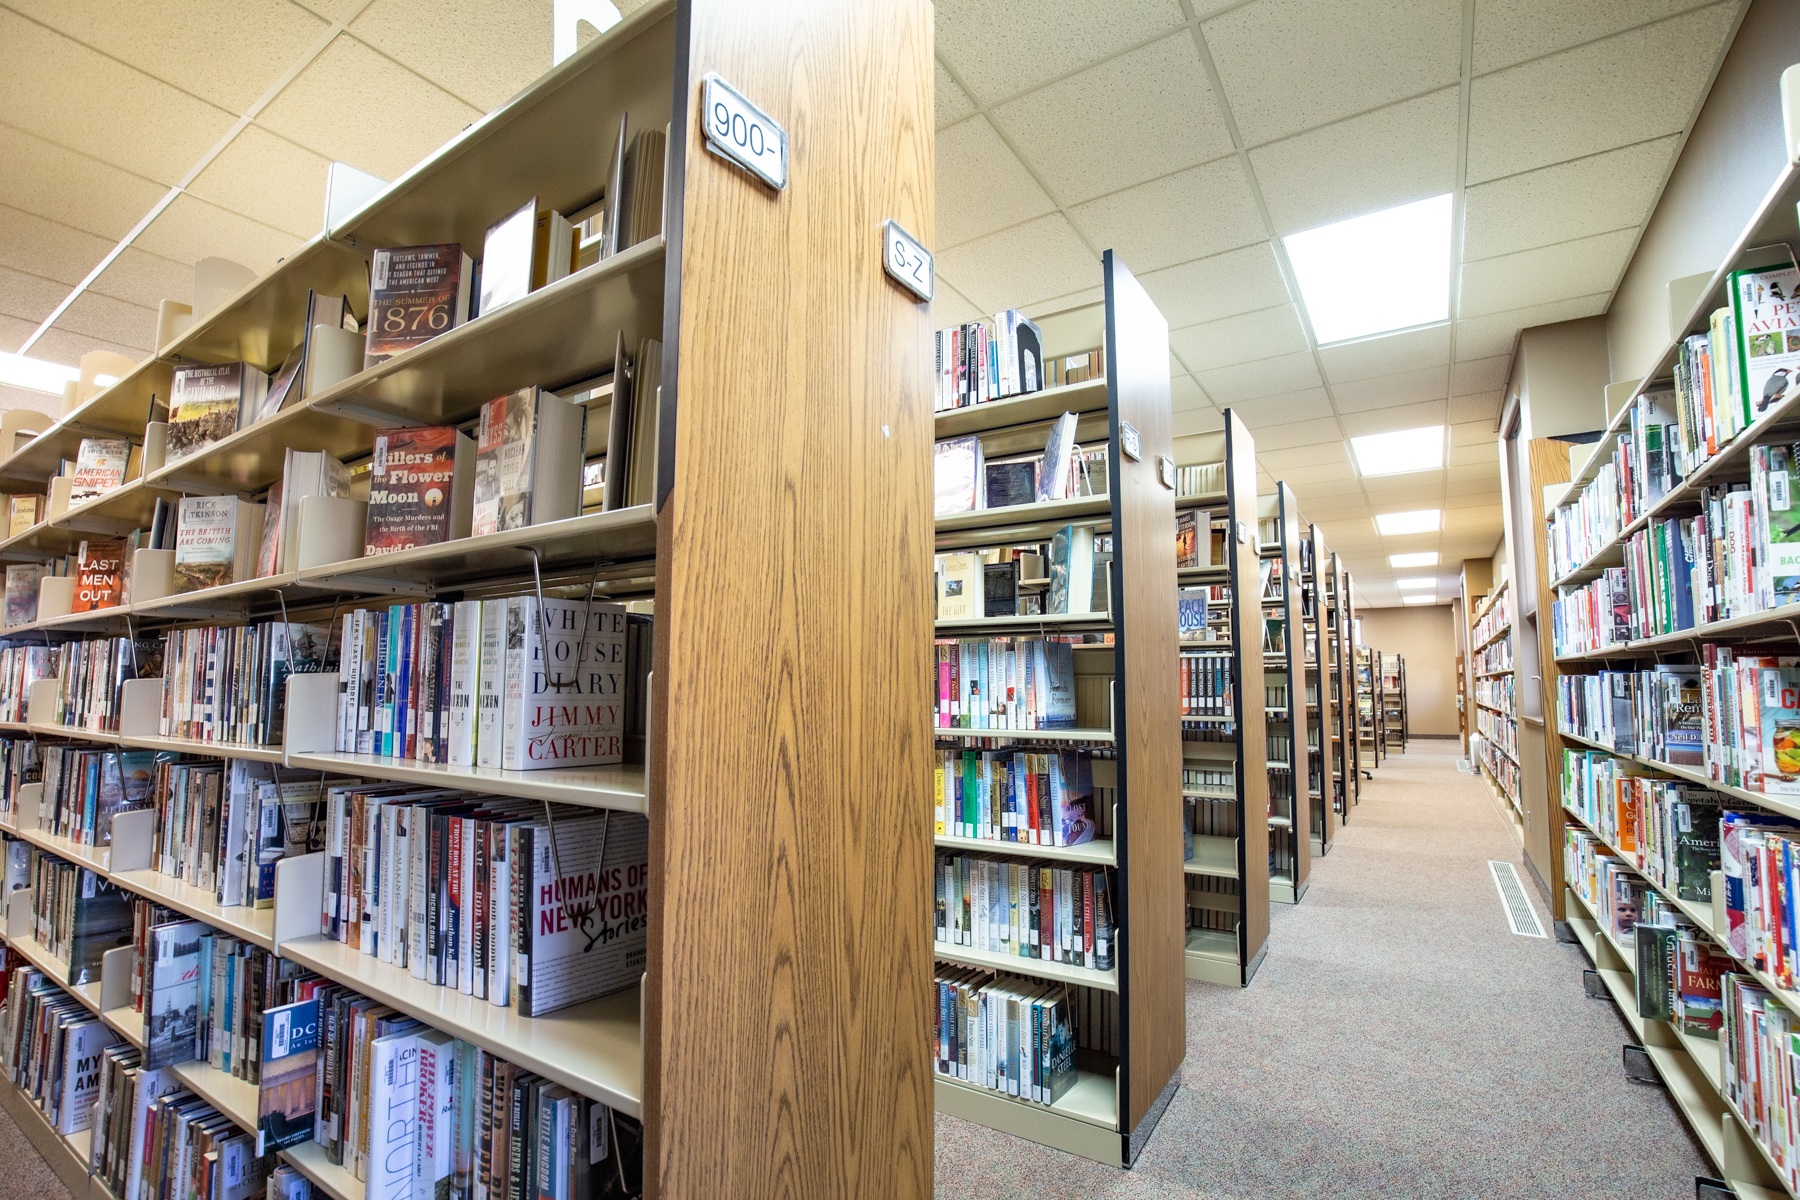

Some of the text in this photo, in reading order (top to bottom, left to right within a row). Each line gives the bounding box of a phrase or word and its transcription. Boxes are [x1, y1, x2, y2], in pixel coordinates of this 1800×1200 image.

[713, 102, 776, 156] 900-
[393, 254, 417, 262] OUTLAWS,
[894, 240, 924, 283] S-Z
[393, 270, 413, 278] SEASON
[413, 269, 426, 277] THAT
[399, 277, 425, 285] AMERICAN
[395, 296, 435, 305] SUMMER
[438, 294, 451, 302] OF
[371, 304, 448, 333] 1876
[185, 367, 230, 378] THE HISTORICAL ATLAS
[206, 377, 215, 385] THE
[187, 385, 226, 402] CIVIL WAR
[436, 451, 447, 462] of
[76, 468, 122, 477] AMERICAN
[374, 470, 454, 485] the Flower
[73, 478, 120, 488] SNIPER
[196, 501, 217, 509] RICK
[370, 490, 418, 505] Moon
[385, 515, 404, 523] Osage
[1179, 516, 1191, 525] JAMES
[179, 527, 231, 537] THE BRITISH
[179, 537, 231, 546] ARE COMING
[80, 559, 119, 571] LAST
[82, 574, 114, 585] MEN
[80, 590, 112, 601] OUT
[1658, 561, 1667, 624] CHILTON
[942, 605, 966, 616] THE GIFT
[349, 668, 357, 708] HUNDRED
[455, 681, 463, 690] THE
[484, 681, 492, 690] THE
[532, 672, 622, 695] DIARY
[1052, 693, 1071, 705] Forever
[532, 705, 619, 727] JIMMY
[1672, 733, 1698, 741] Neil D.
[528, 735, 622, 761] CARTER
[1069, 803, 1086, 813] LOST
[1069, 821, 1092, 833] FOUND
[476, 829, 484, 867] FEAR
[452, 869, 459, 879] AT
[540, 863, 648, 906] HUMANS OF
[518, 912, 524, 922] OF
[540, 888, 648, 937] NEW YORK
[448, 908, 456, 946] Jonathan
[580, 913, 647, 953] Stories
[940, 985, 948, 1021] DANIELLE STEEL
[291, 1022, 317, 1039] DC
[1020, 1005, 1028, 1046] DANIELLE STEEL
[1051, 1040, 1077, 1070] DANIELLE
[325, 1048, 334, 1083] MORNING
[455, 1048, 463, 1090] DREAMS
[1057, 1056, 1072, 1077] STEEL
[418, 1048, 429, 1124] BROKER
[425, 1048, 436, 1158] THE POWER
[481, 1078, 493, 1141] DODGE
[513, 1102, 521, 1131] O'REILLY'S
[511, 1136, 522, 1173] LEGENDS
[540, 1107, 551, 1191] CATTLE KINGDOM
